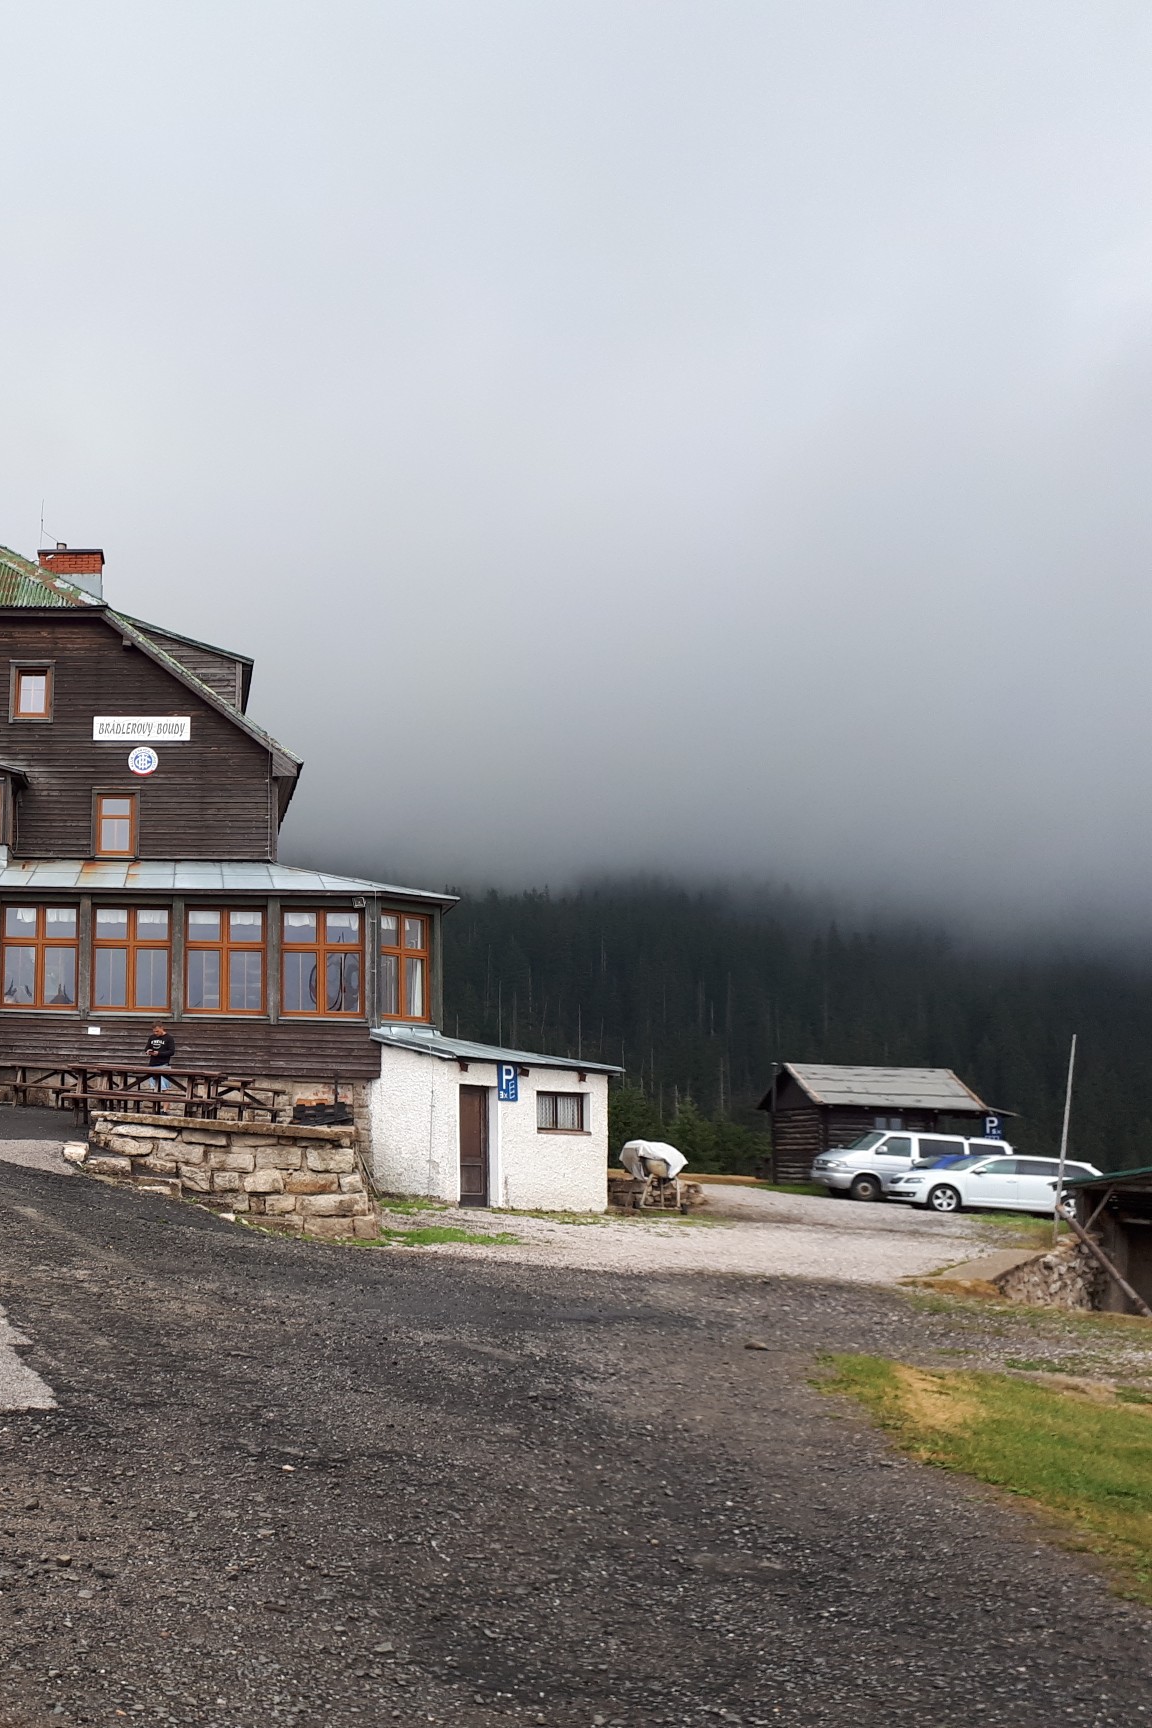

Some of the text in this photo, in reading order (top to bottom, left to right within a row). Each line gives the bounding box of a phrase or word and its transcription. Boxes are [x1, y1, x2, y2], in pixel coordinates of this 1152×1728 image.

[157, 722, 187, 738] BOUDY
[502, 1065, 514, 1090] P
[985, 1116, 999, 1134] P
